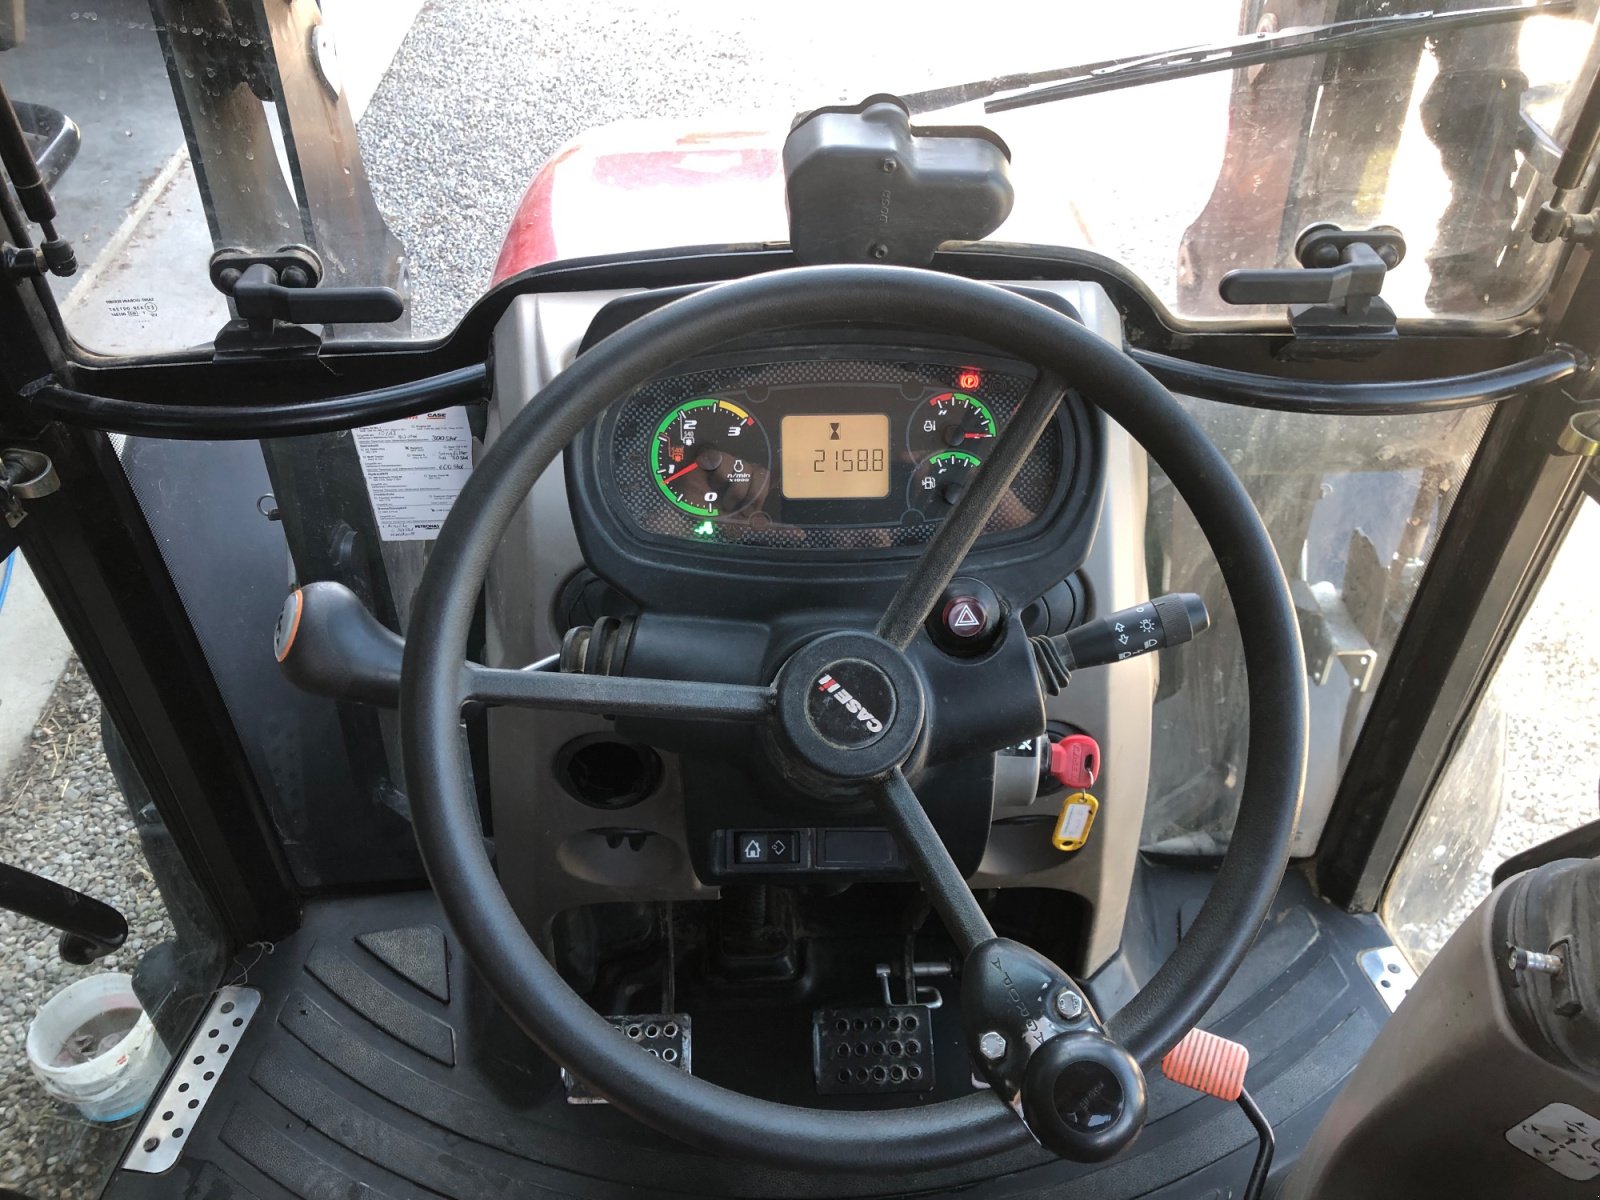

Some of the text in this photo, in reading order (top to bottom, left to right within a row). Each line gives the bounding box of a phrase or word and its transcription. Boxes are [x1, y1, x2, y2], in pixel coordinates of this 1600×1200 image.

[683, 420, 698, 430] 2
[728, 426, 742, 437] 3
[813, 448, 884, 473] 2158.8
[668, 464, 675, 474] 1
[704, 492, 718, 502] 0
[834, 688, 883, 733] CASE
